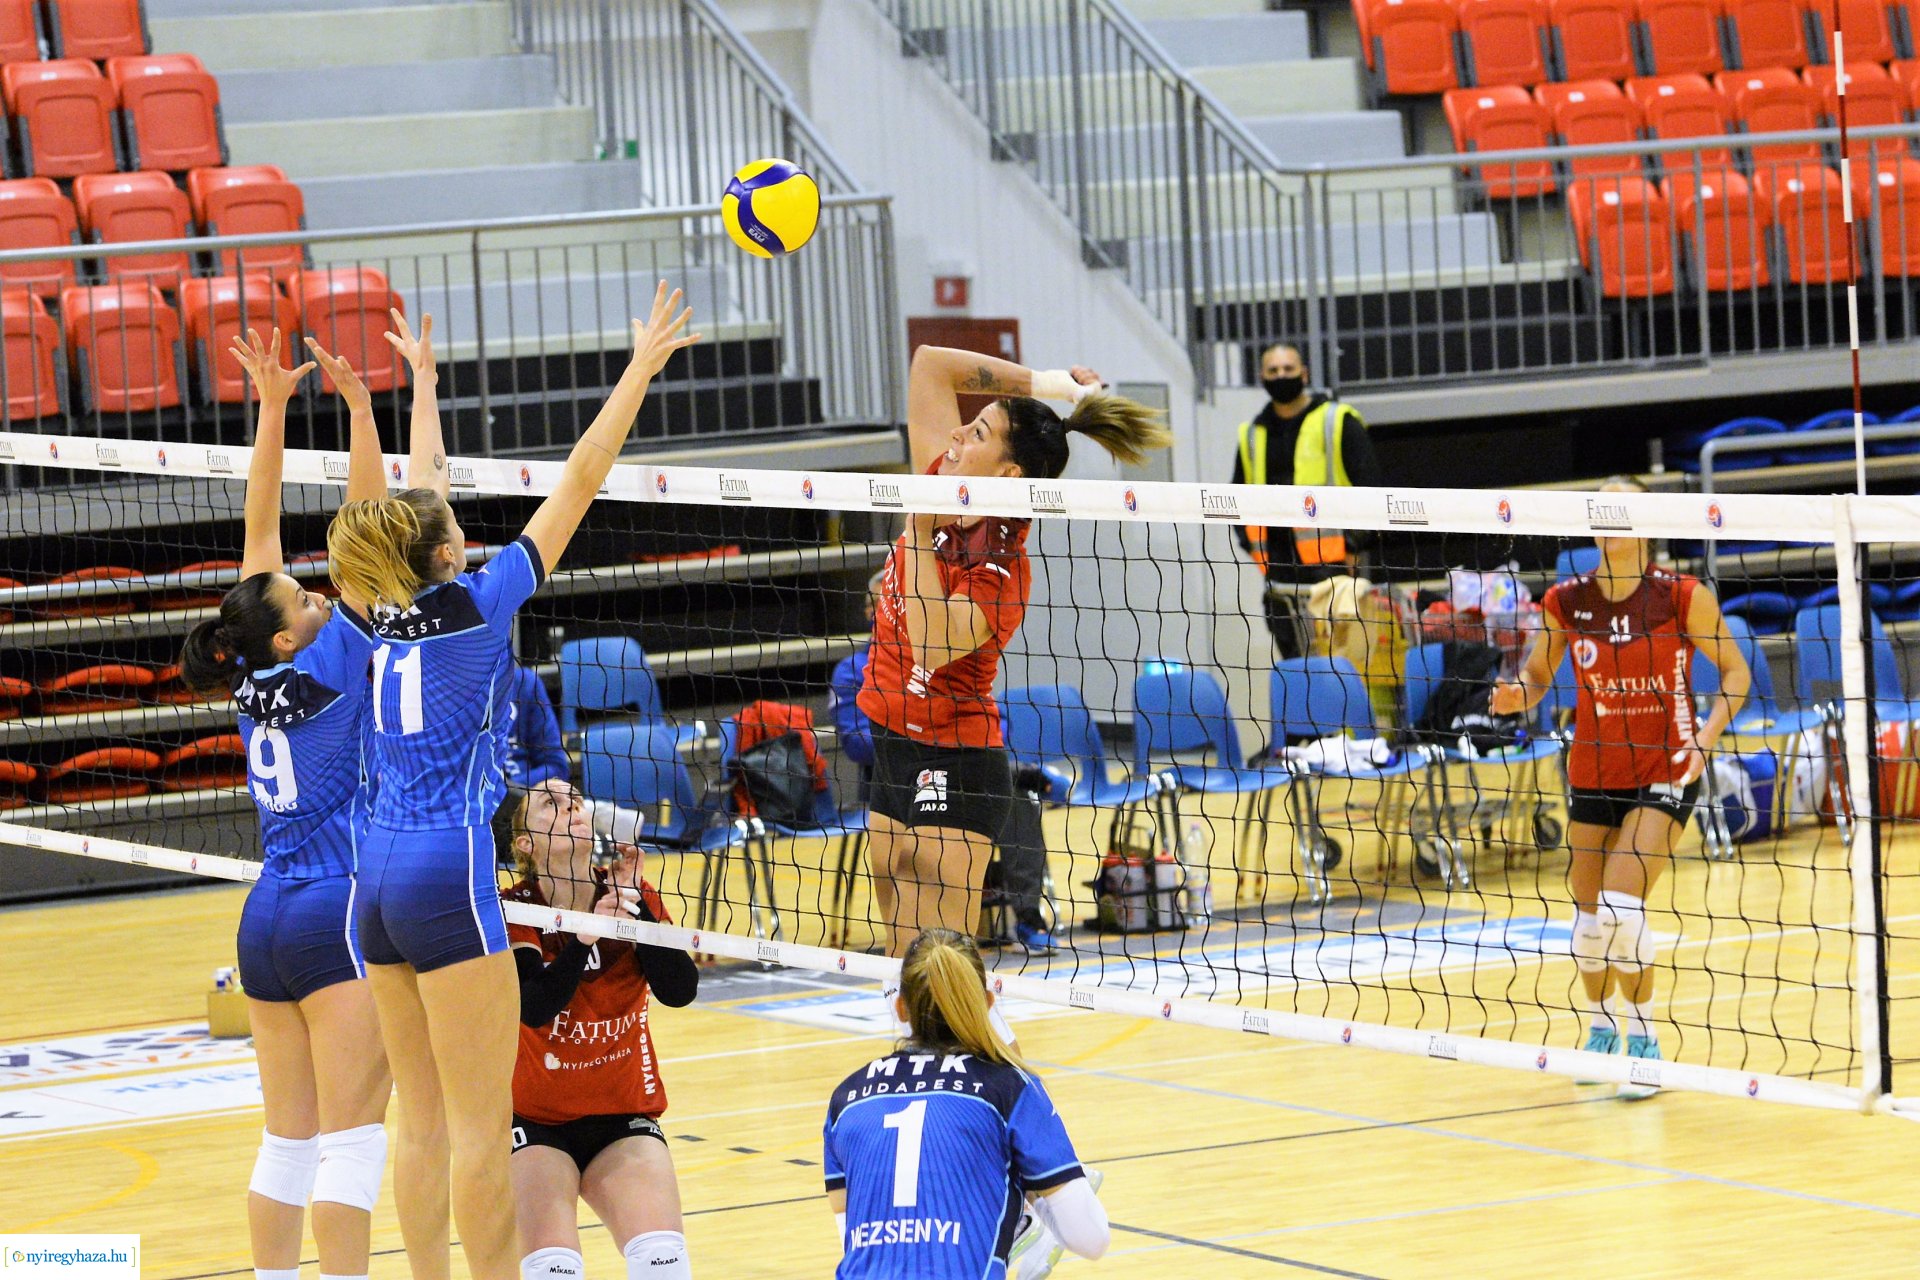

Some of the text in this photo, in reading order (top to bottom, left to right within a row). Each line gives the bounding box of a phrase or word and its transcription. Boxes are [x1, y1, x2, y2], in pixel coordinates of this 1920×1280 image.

[96, 443, 119, 459] FATUM
[206, 450, 230, 467] FATUM
[323, 456, 348, 473] FATUM
[448, 462, 474, 480] FATUM
[719, 474, 749, 492] FATUM
[868, 479, 900, 498] FATUM
[1029, 485, 1063, 504] FATUM
[1200, 489, 1238, 509] FATUM
[1386, 494, 1426, 515] FATUM
[1586, 499, 1630, 520] FATUM
[1609, 615, 1632, 643] 11
[373, 643, 424, 735] 11
[1589, 673, 1667, 695] FATUM
[249, 725, 298, 805] 9
[583, 943, 601, 971] 0
[757, 941, 779, 958] FATUM
[1069, 987, 1094, 1005] FATUM
[550, 1009, 637, 1039] FATUM
[1242, 1010, 1269, 1028] FATUM
[866, 1054, 974, 1079] MTK
[847, 1079, 984, 1102] BUDAPEST
[883, 1099, 928, 1208] 1
